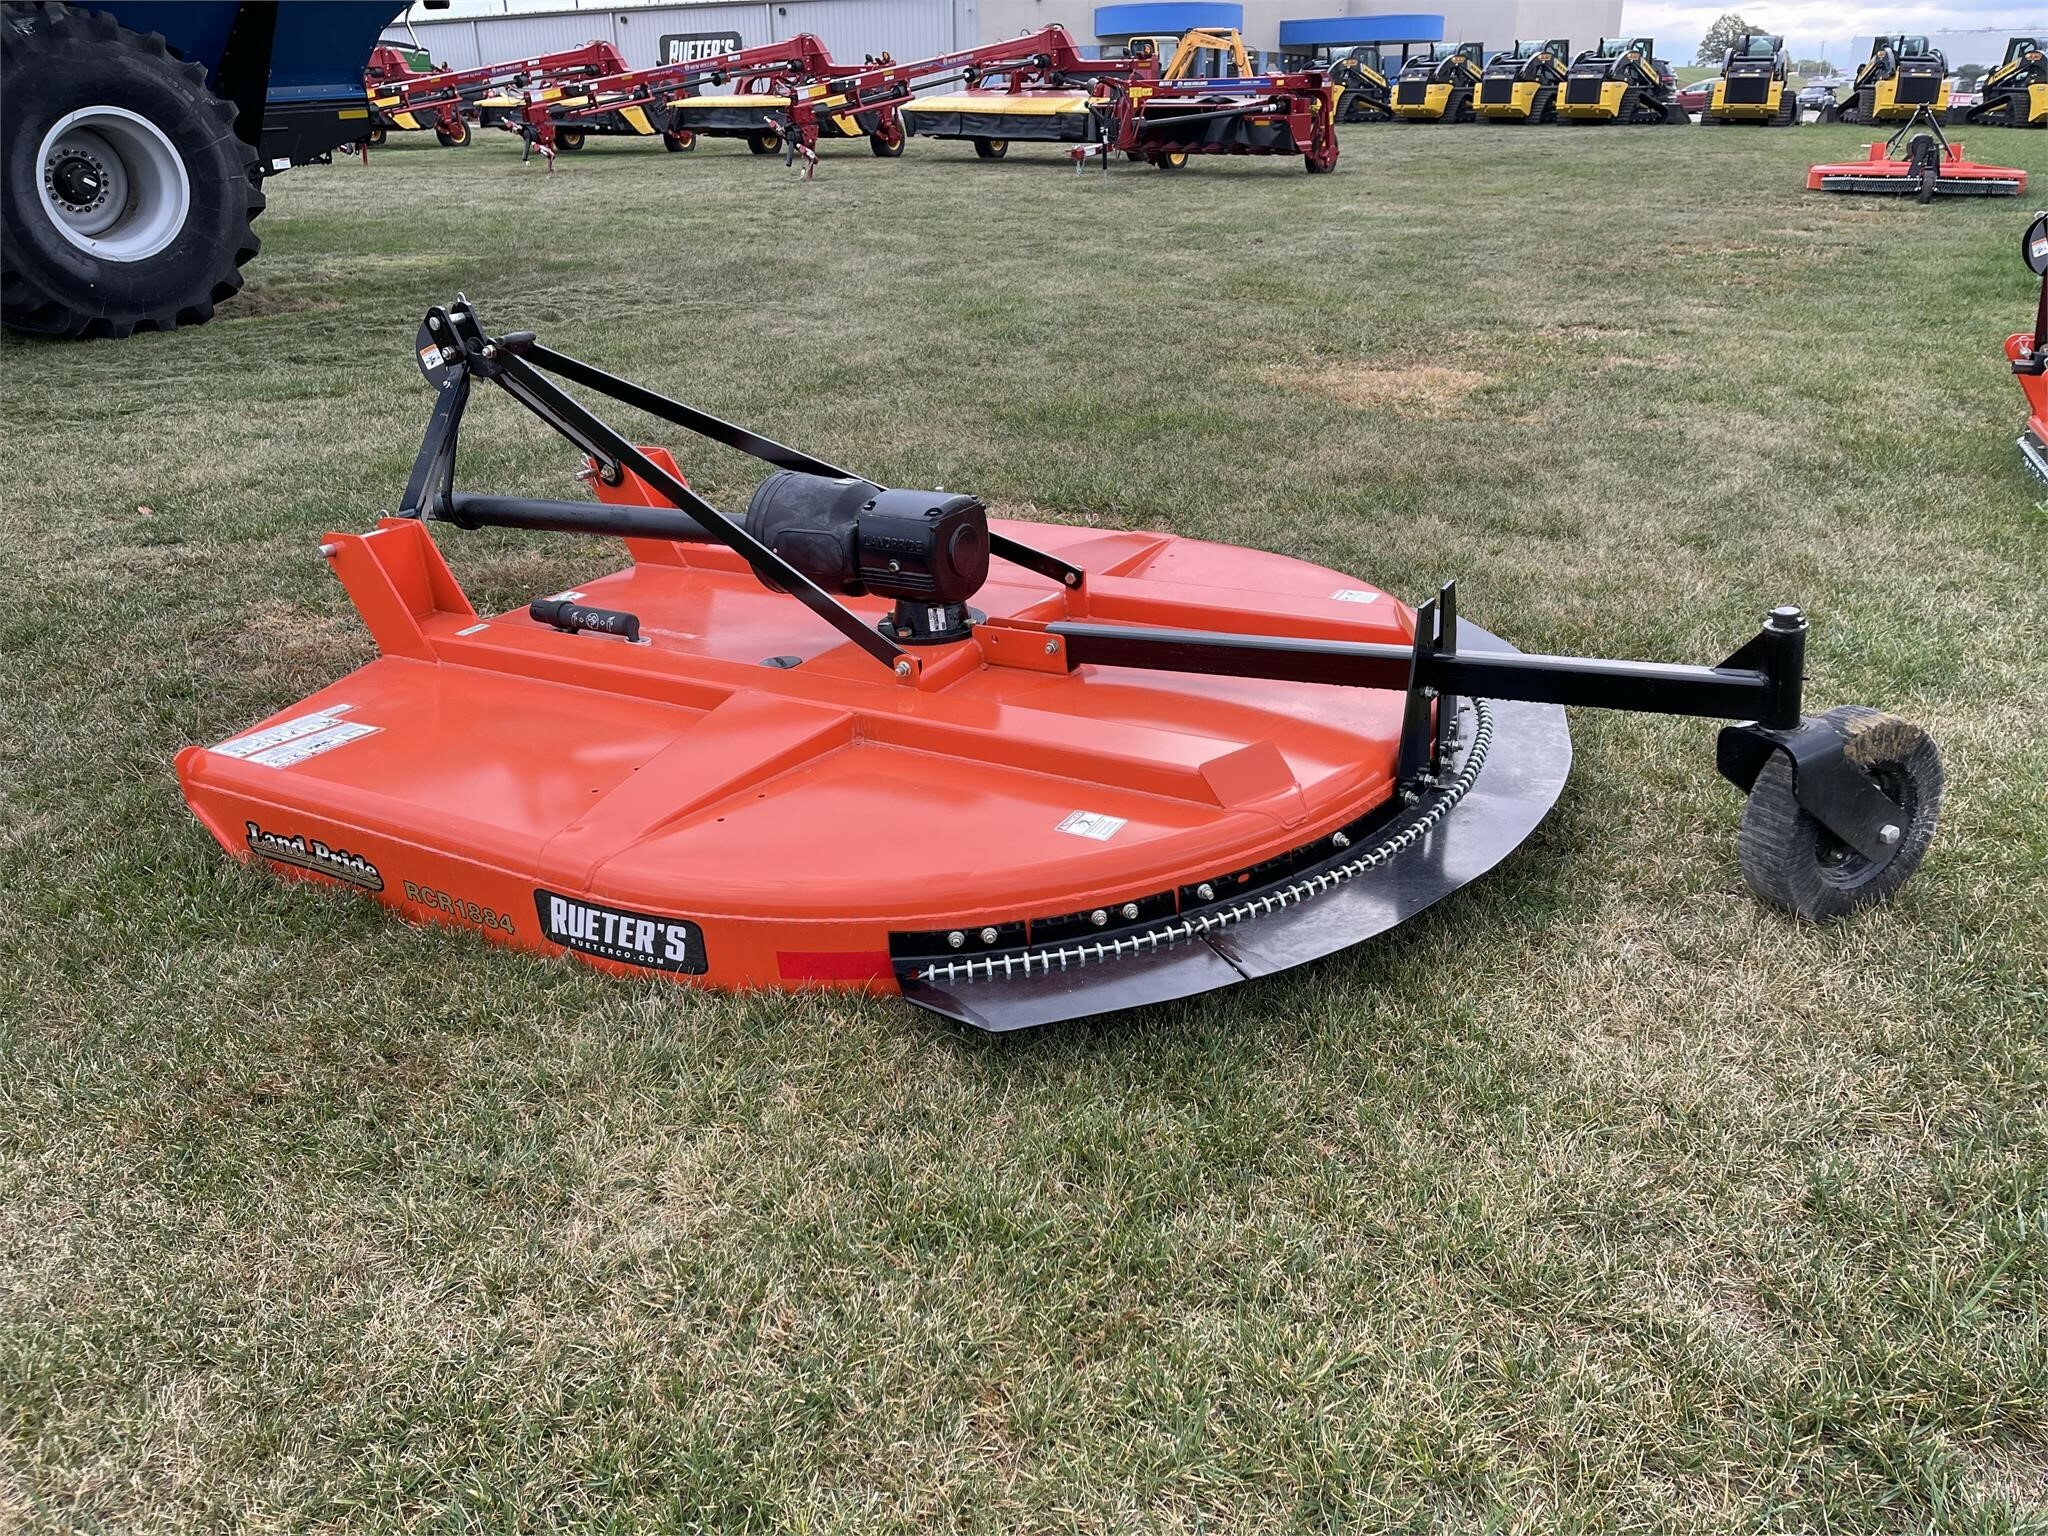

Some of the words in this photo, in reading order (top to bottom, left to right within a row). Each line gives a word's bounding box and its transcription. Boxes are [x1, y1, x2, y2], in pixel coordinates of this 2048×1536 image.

[246, 821, 308, 859] Land
[311, 839, 379, 882] Pride
[403, 880, 515, 935] RCR1884
[550, 896, 687, 962] RUETER'S
[570, 937, 664, 965] RUETERCO.COM
